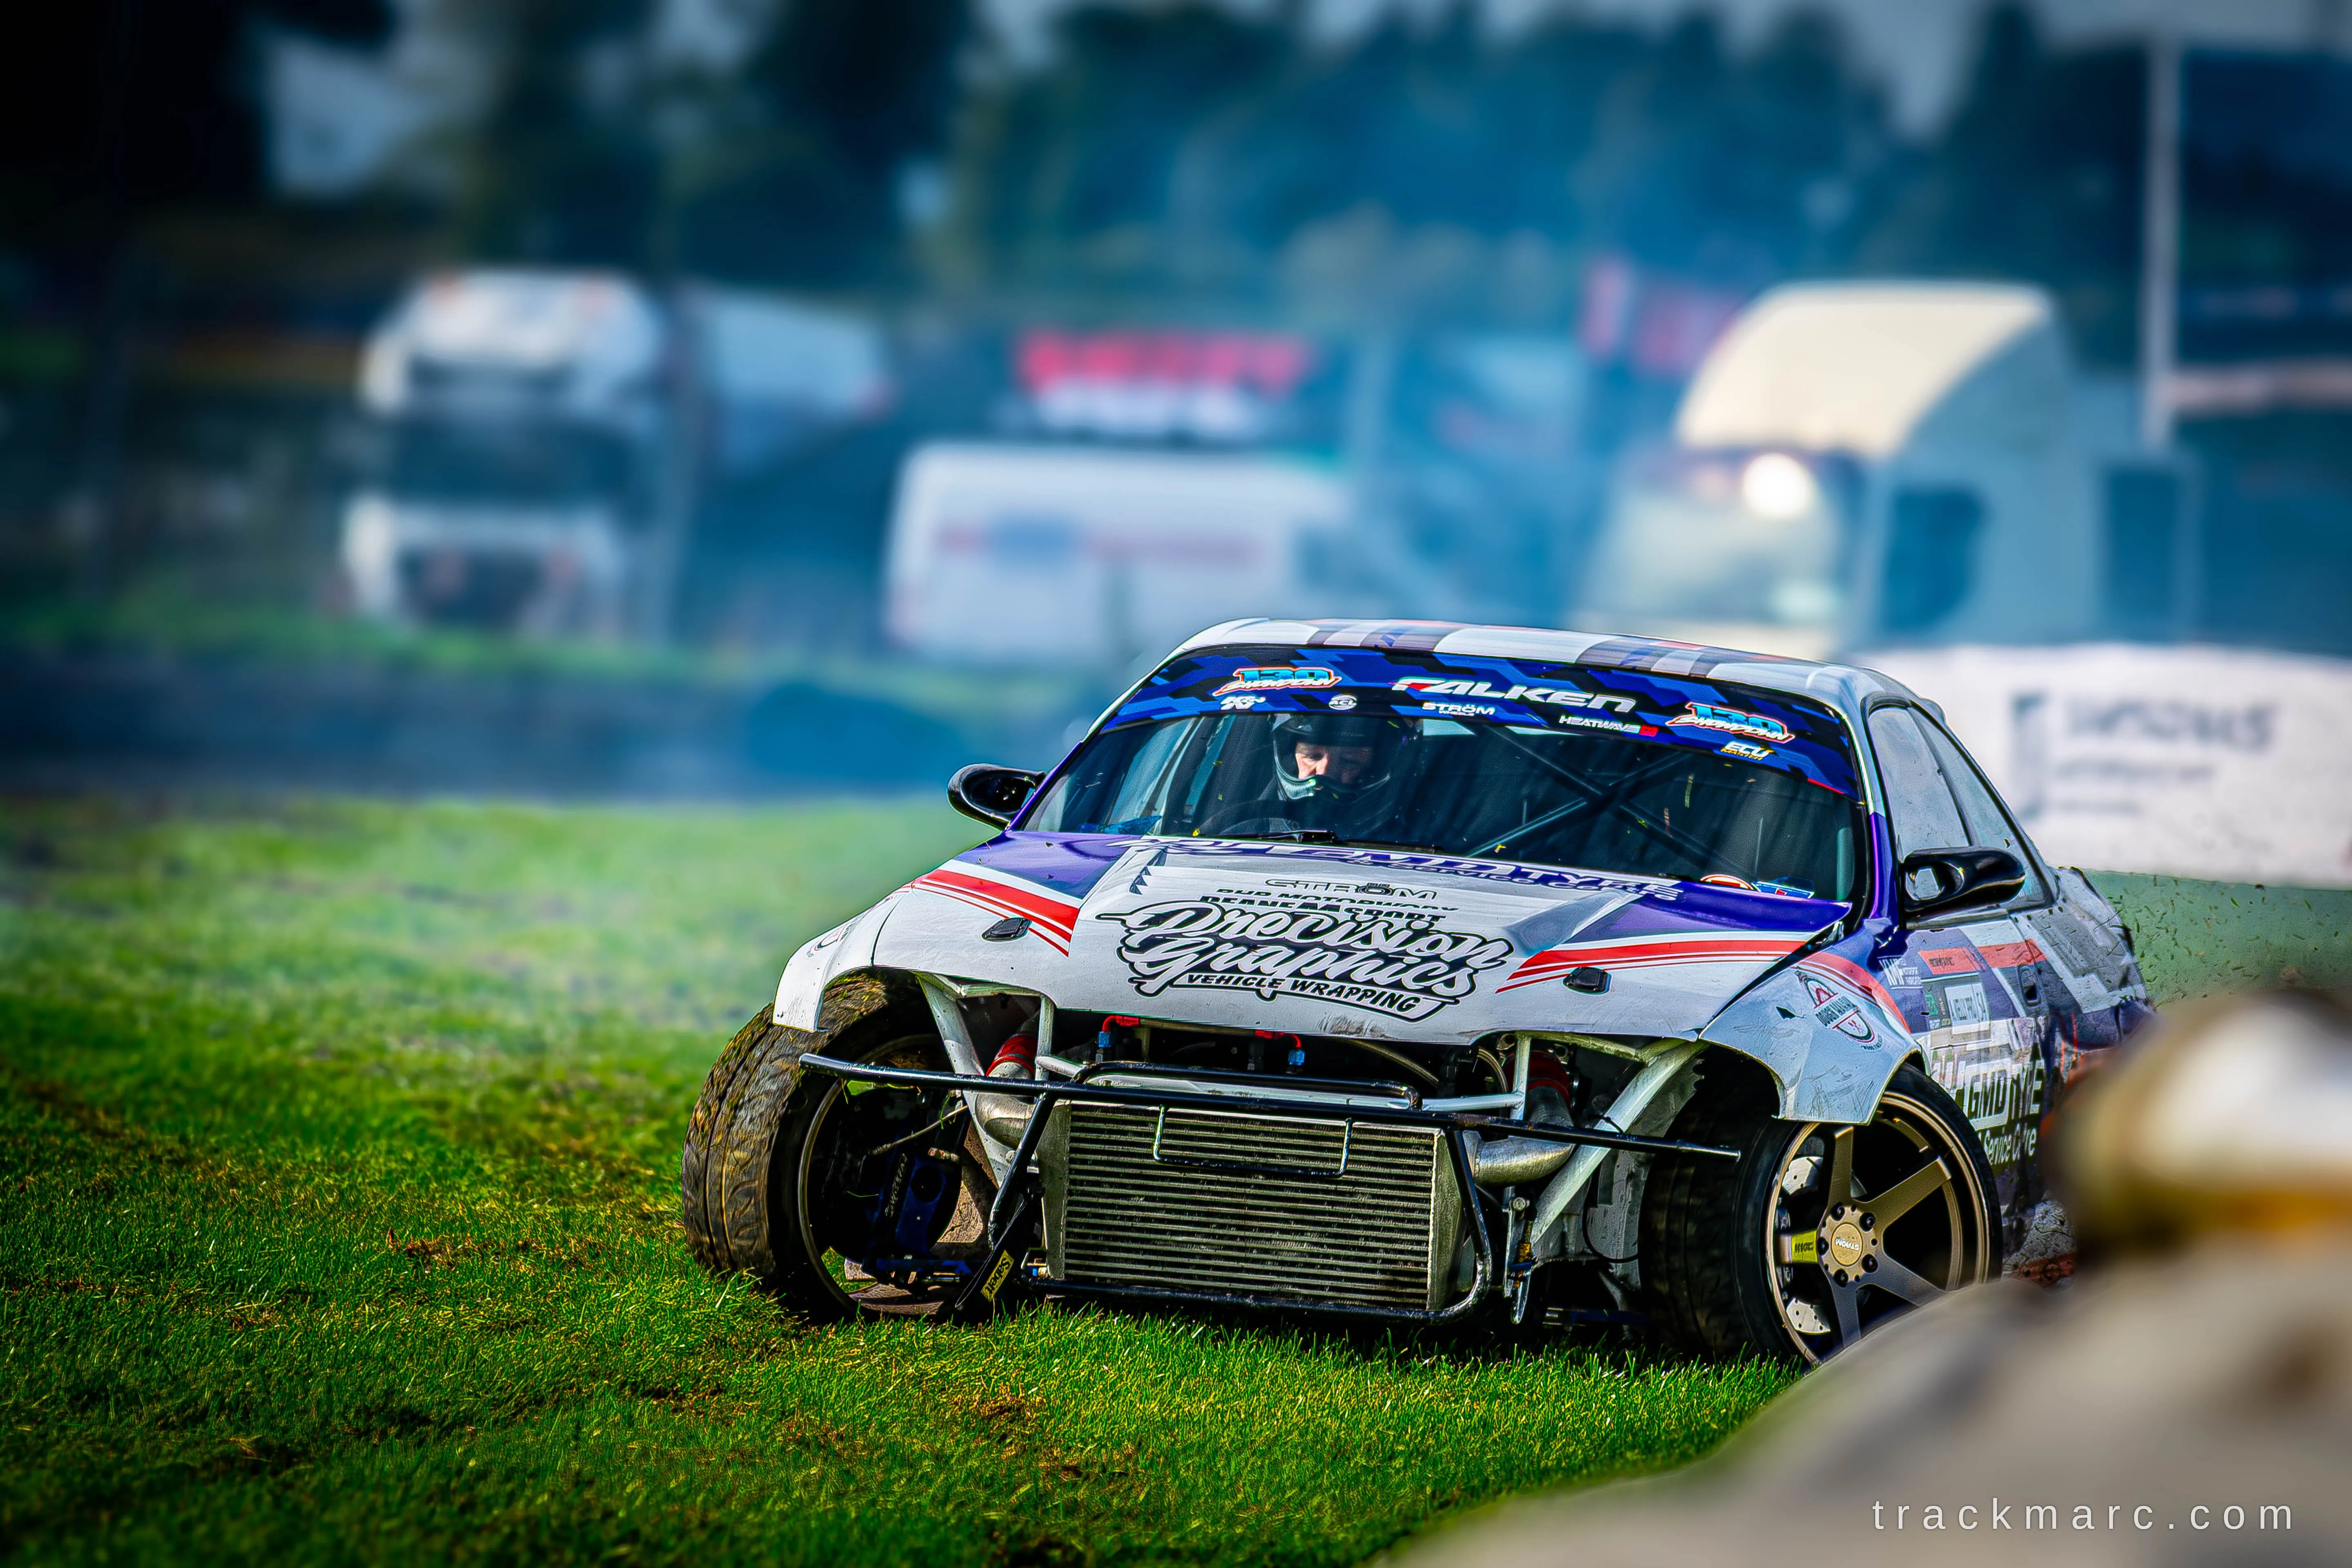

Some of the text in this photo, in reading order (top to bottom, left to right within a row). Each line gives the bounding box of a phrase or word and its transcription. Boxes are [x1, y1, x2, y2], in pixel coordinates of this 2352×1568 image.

[1240, 669, 1329, 682] 130
[1390, 676, 1636, 713] FALKEN
[1422, 702, 1495, 715] STRÖM
[1559, 715, 1641, 733] HEATWAVE
[1675, 716, 1789, 740] SHOWDOWN
[1691, 704, 1784, 735] 130
[1724, 741, 1770, 758] ECU
[1521, 868, 1684, 897] TYRE
[1124, 901, 1509, 969] Precision
[1122, 937, 1473, 998] Graphics
[1187, 974, 1421, 1013] VEHICLE WRAPPING
[984, 1257, 1010, 1294] Sabelt
